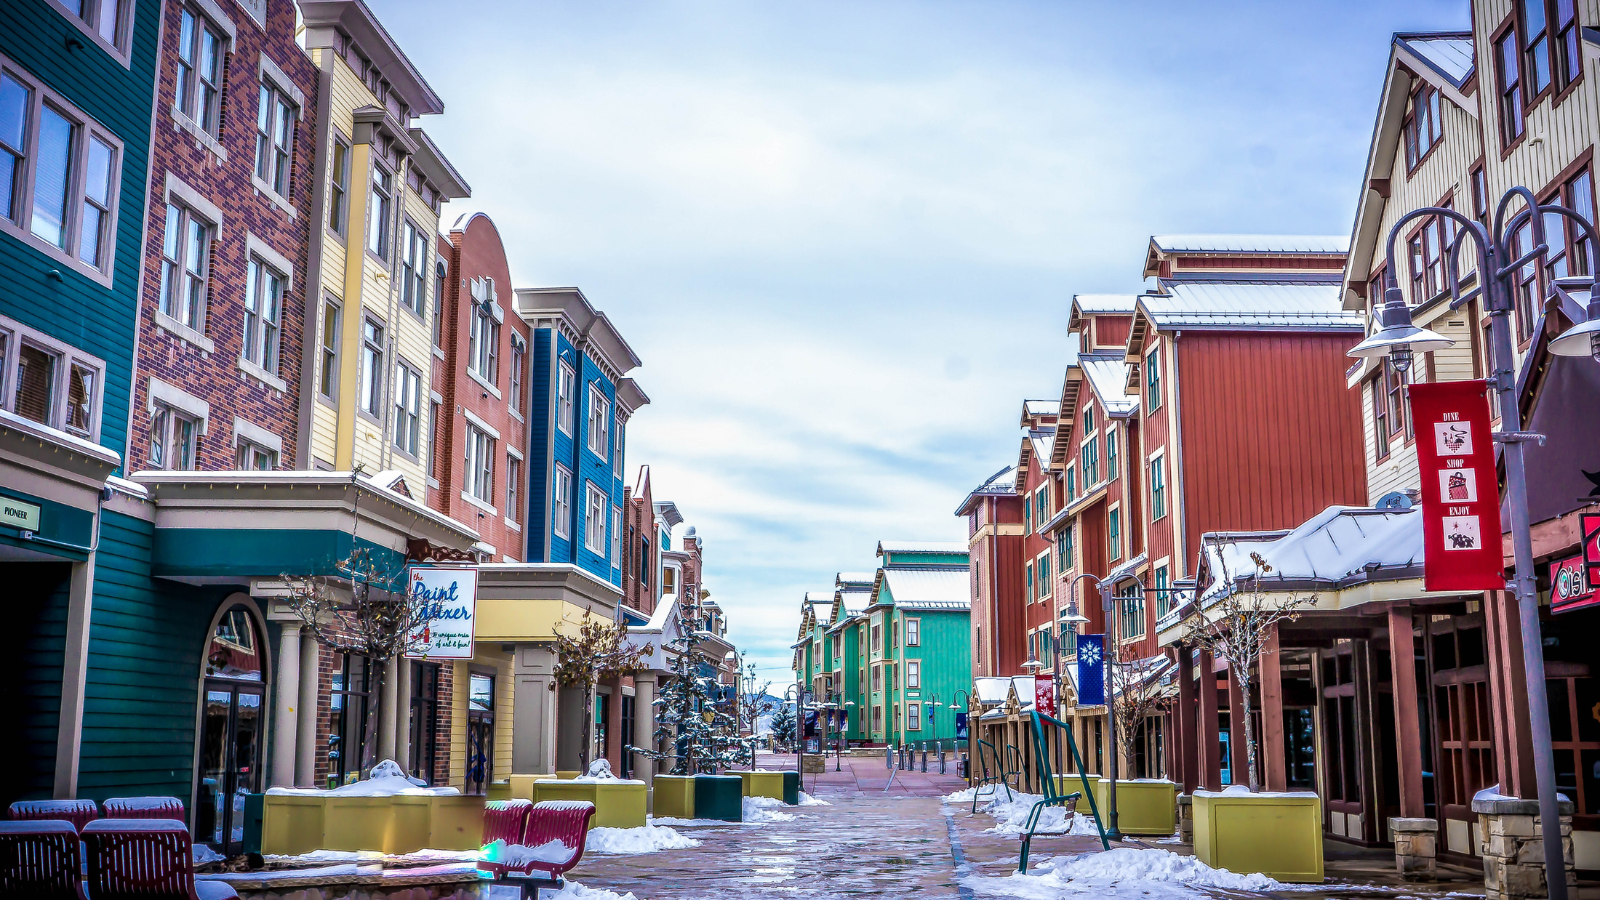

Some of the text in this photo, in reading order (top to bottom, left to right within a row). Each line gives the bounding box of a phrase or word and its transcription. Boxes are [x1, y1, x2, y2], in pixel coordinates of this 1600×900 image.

[1443, 412, 1459, 421] DINE
[1446, 459, 1465, 469] SHOP
[4, 506, 28, 520] PIONEER
[1449, 506, 1470, 516] ENJOY
[413, 573, 423, 581] the
[1558, 563, 1596, 600] Oish
[414, 581, 459, 601] Paint
[438, 632, 457, 640] unique
[435, 639, 441, 648] of
[457, 640, 470, 649] fun!
